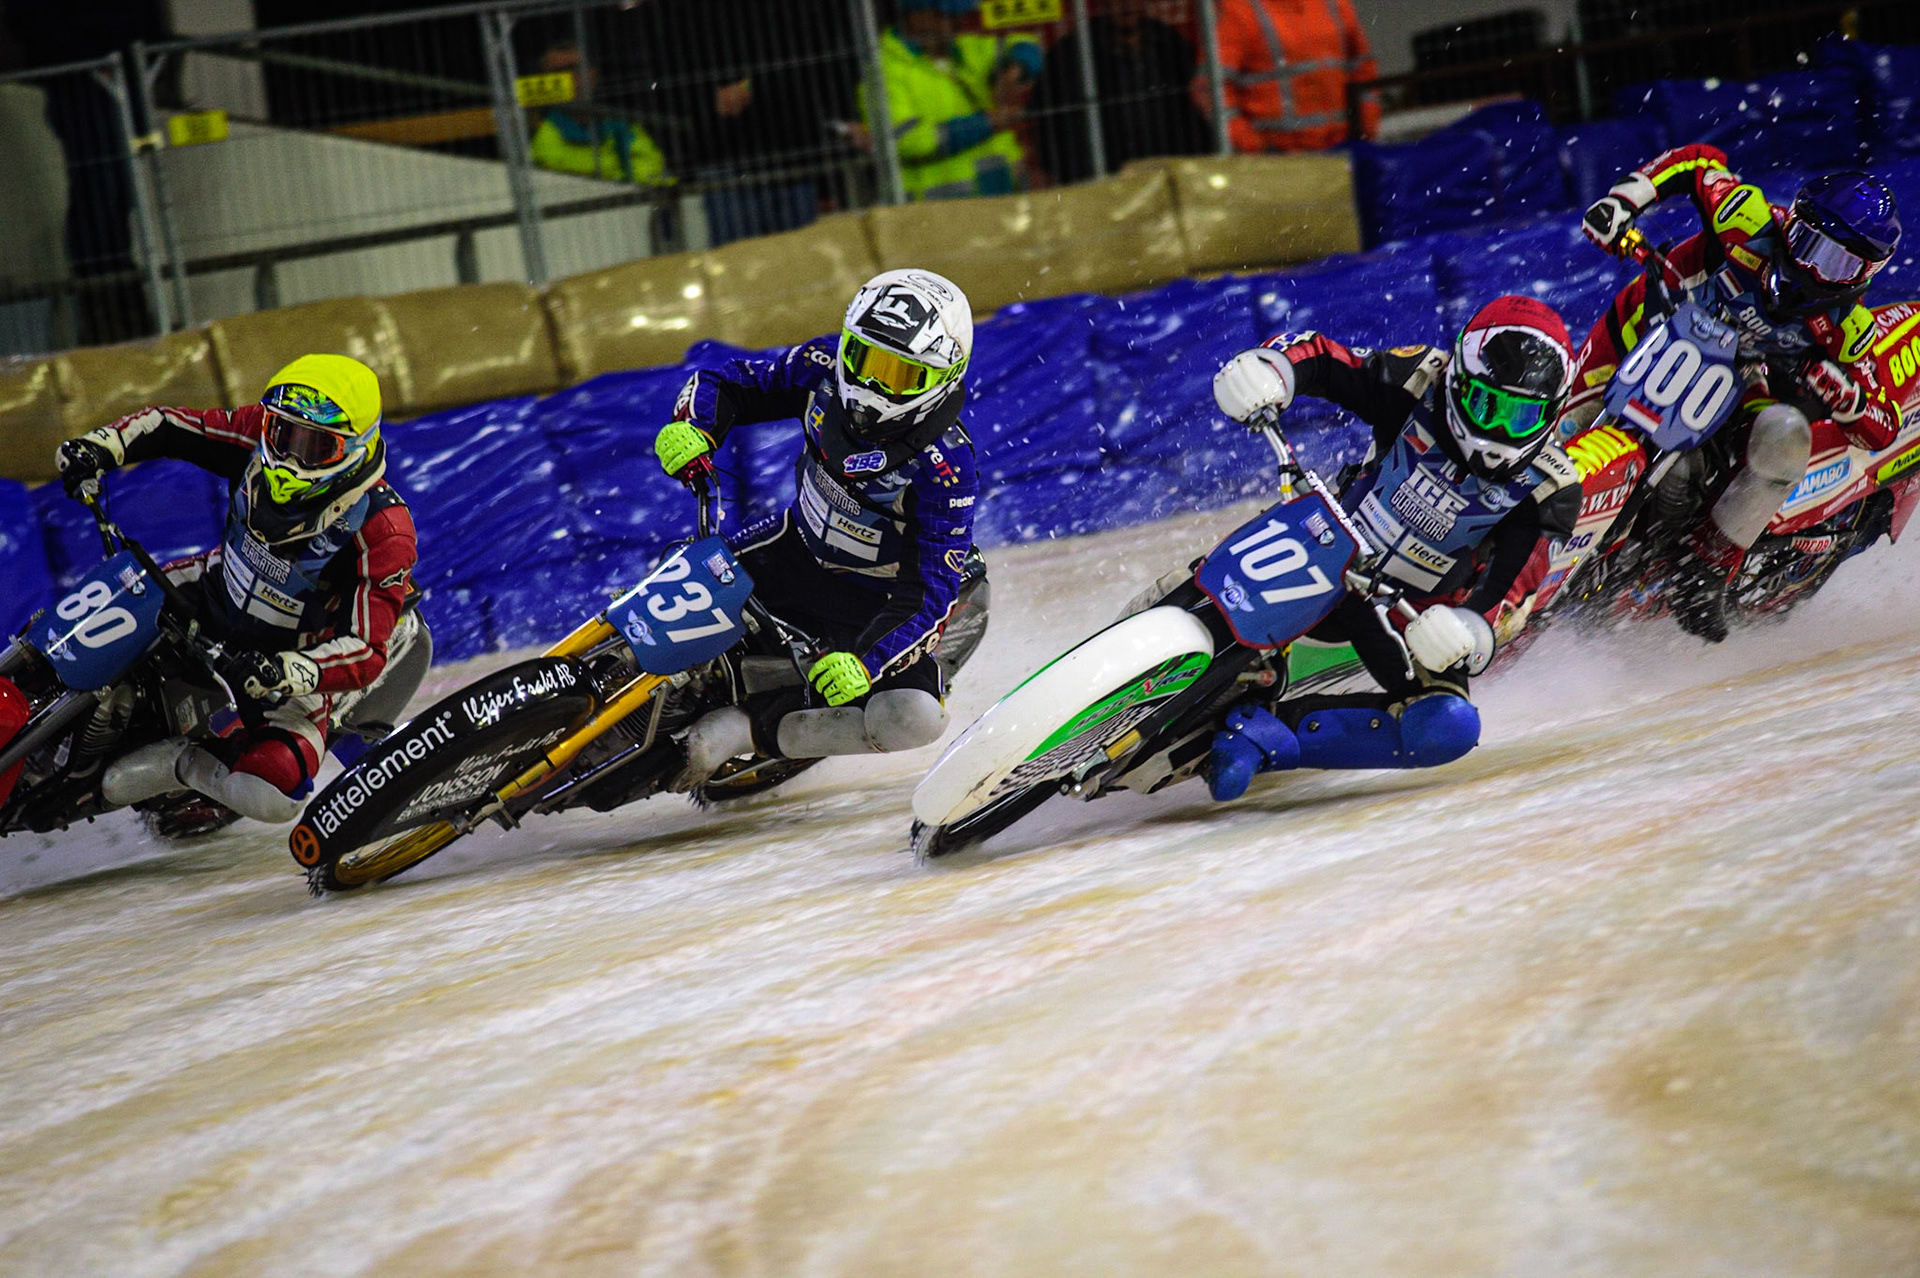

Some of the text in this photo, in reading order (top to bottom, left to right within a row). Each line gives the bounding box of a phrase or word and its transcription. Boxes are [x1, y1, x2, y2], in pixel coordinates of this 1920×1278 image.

[1739, 306, 1773, 336] 800
[1618, 323, 1735, 432] 800
[1407, 463, 1470, 522] ICE
[1796, 463, 1845, 498] JAMABO
[837, 518, 876, 540] Hertz
[1408, 542, 1450, 568] Hertz
[1229, 519, 1334, 604] 107
[56, 580, 137, 648] 80
[261, 585, 298, 610] Hertz
[637, 555, 735, 643] 237
[312, 717, 455, 839] lättelement
[557, 663, 577, 693] AB
[409, 761, 510, 807] JONSSON
